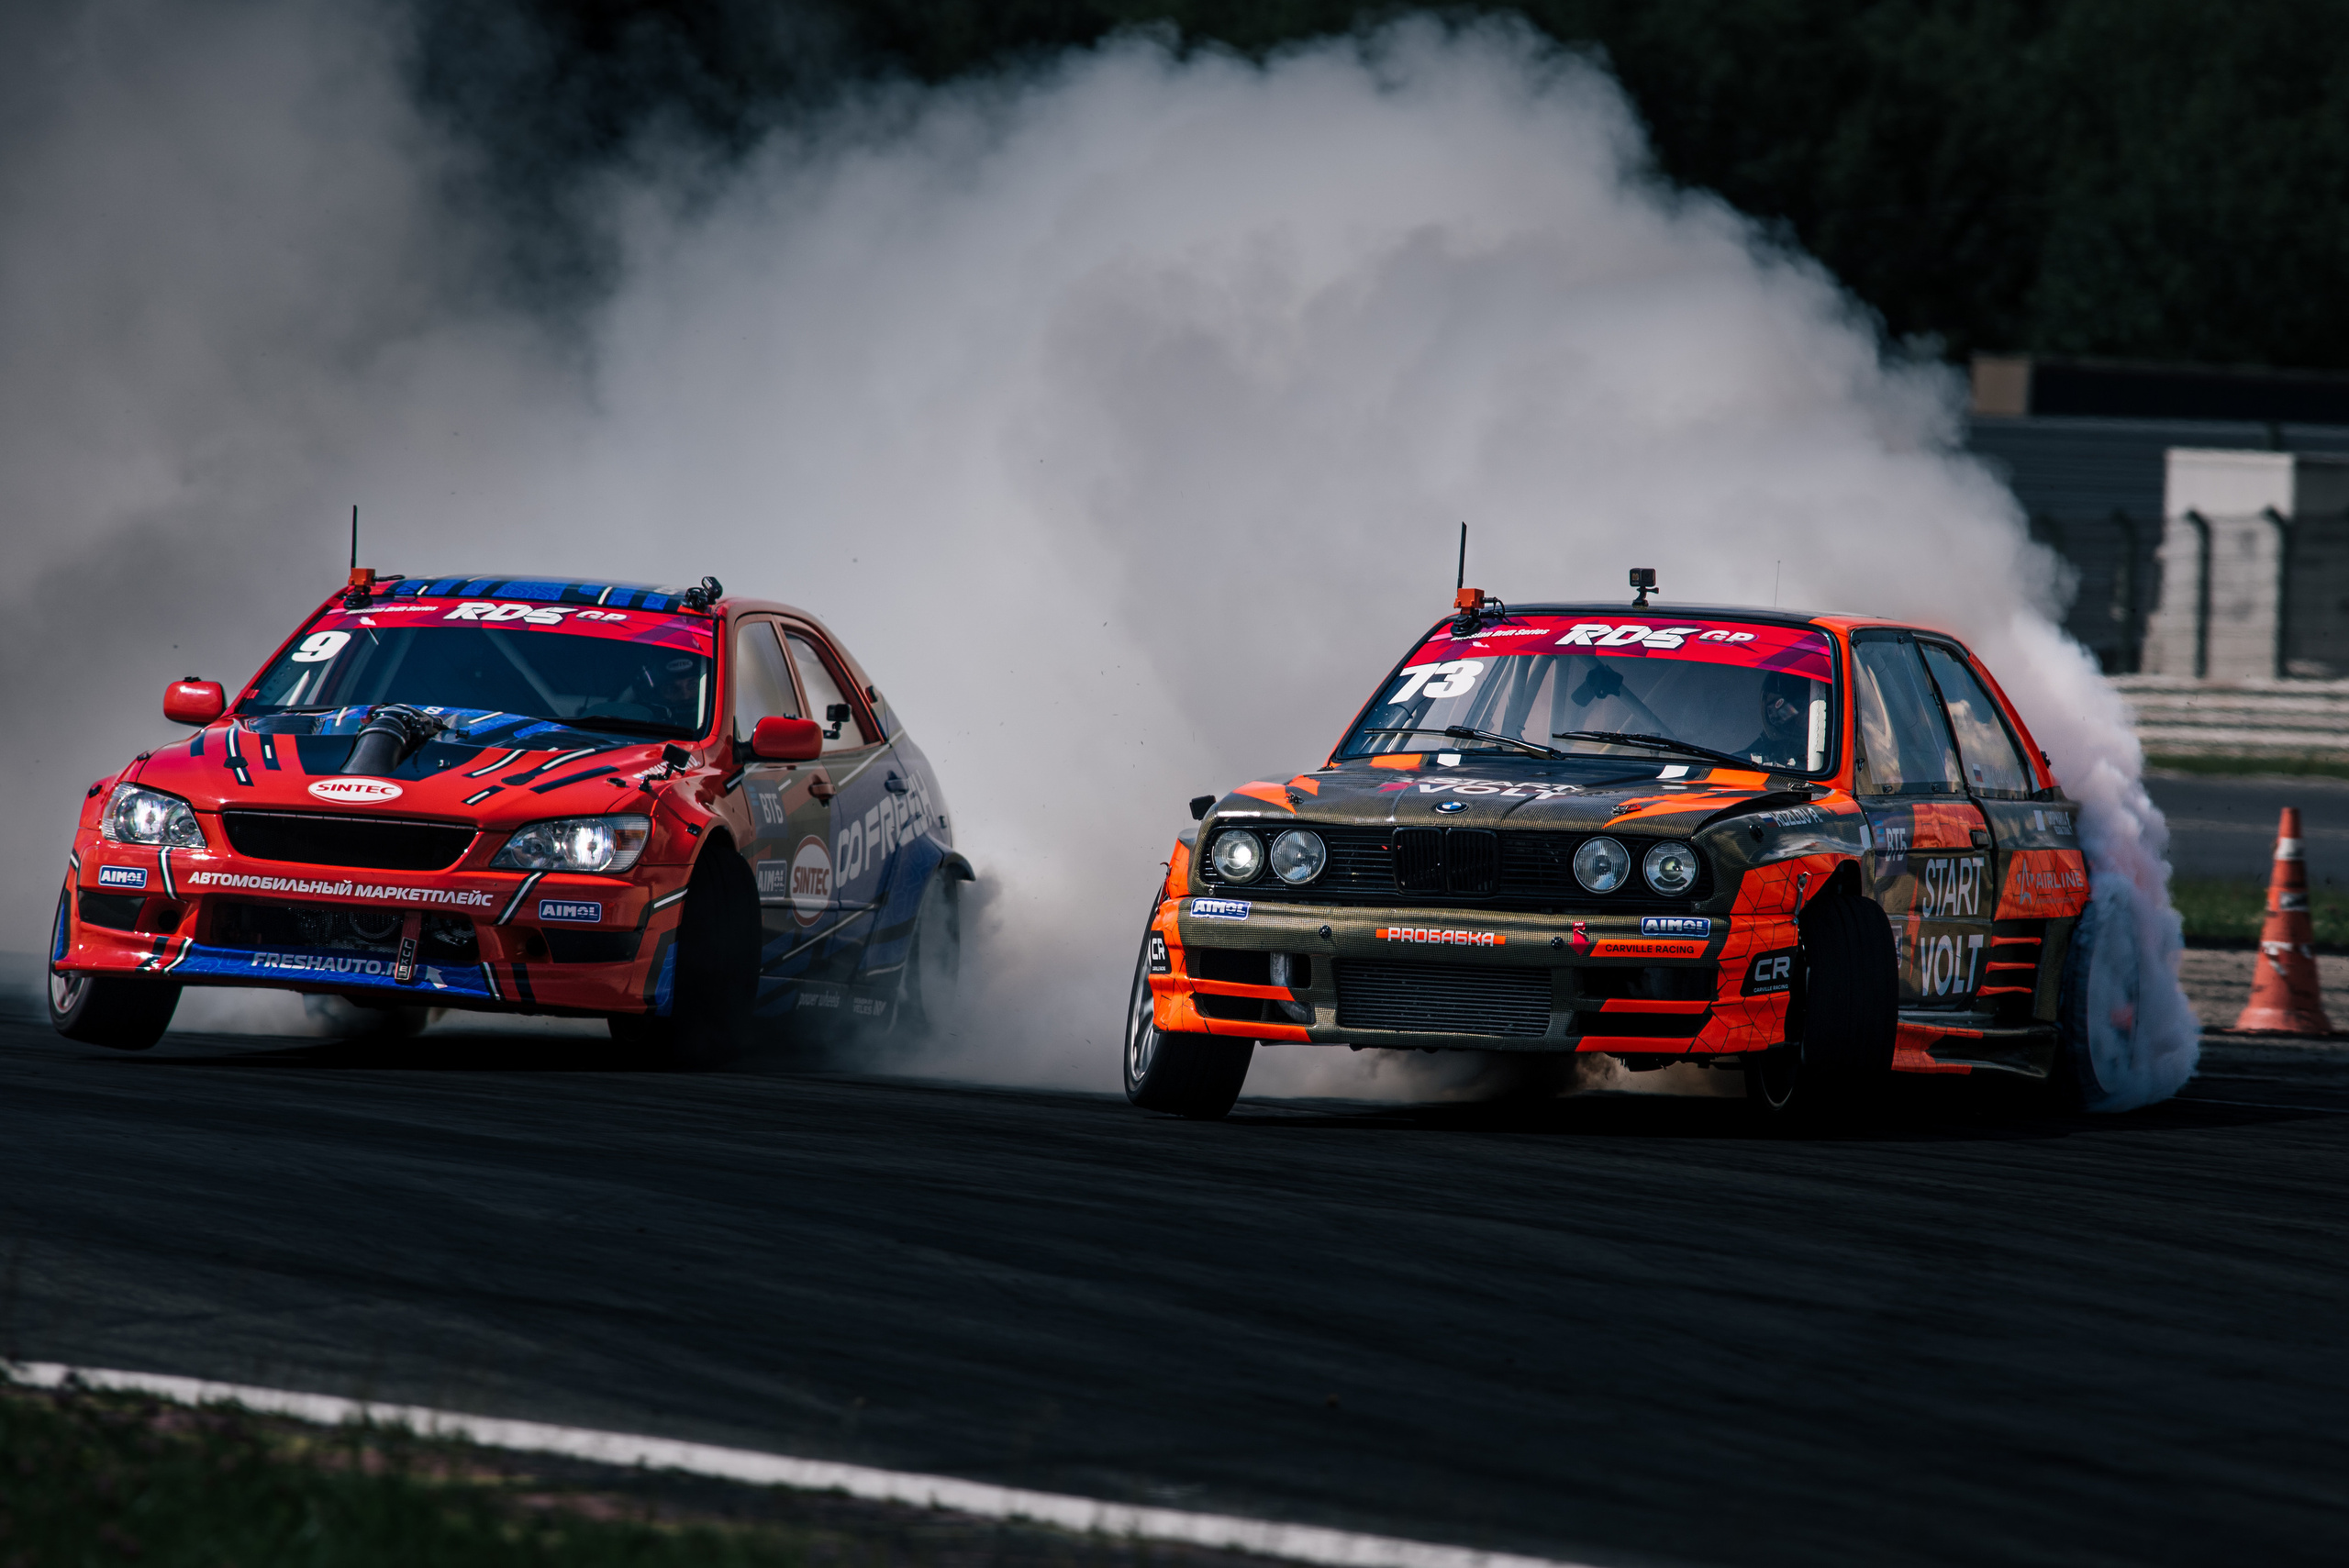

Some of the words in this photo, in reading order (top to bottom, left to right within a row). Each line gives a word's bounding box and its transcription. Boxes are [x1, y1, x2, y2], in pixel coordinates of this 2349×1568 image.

[443, 602, 579, 626] RDS
[575, 610, 629, 622] GP
[292, 630, 351, 662] 9
[1554, 624, 1702, 650] RDS
[1698, 629, 1757, 646] GP
[1388, 660, 1485, 705] 73
[316, 784, 395, 795] SINTEC
[1419, 784, 1566, 800] VOLT
[1428, 777, 1581, 792] START
[101, 870, 144, 884] AIMOL
[758, 870, 784, 892] AIMOL
[792, 866, 829, 895] SINTEC
[1922, 857, 1985, 918] START
[2036, 872, 2084, 889] AIRLINE
[187, 871, 353, 896] АВТОМОБИЛЬНЫЙ
[354, 884, 494, 906] МАРКЕТПЛЕЙС
[542, 904, 598, 918] AIMOL
[1193, 900, 1246, 916] AIMOL
[1644, 918, 1707, 933] AIMOL
[1152, 938, 1165, 960] CR
[1605, 944, 1653, 953] CARVILLE
[1655, 945, 1695, 954] RACING
[1754, 956, 1790, 981] CR
[1920, 934, 1985, 996] VOLT
